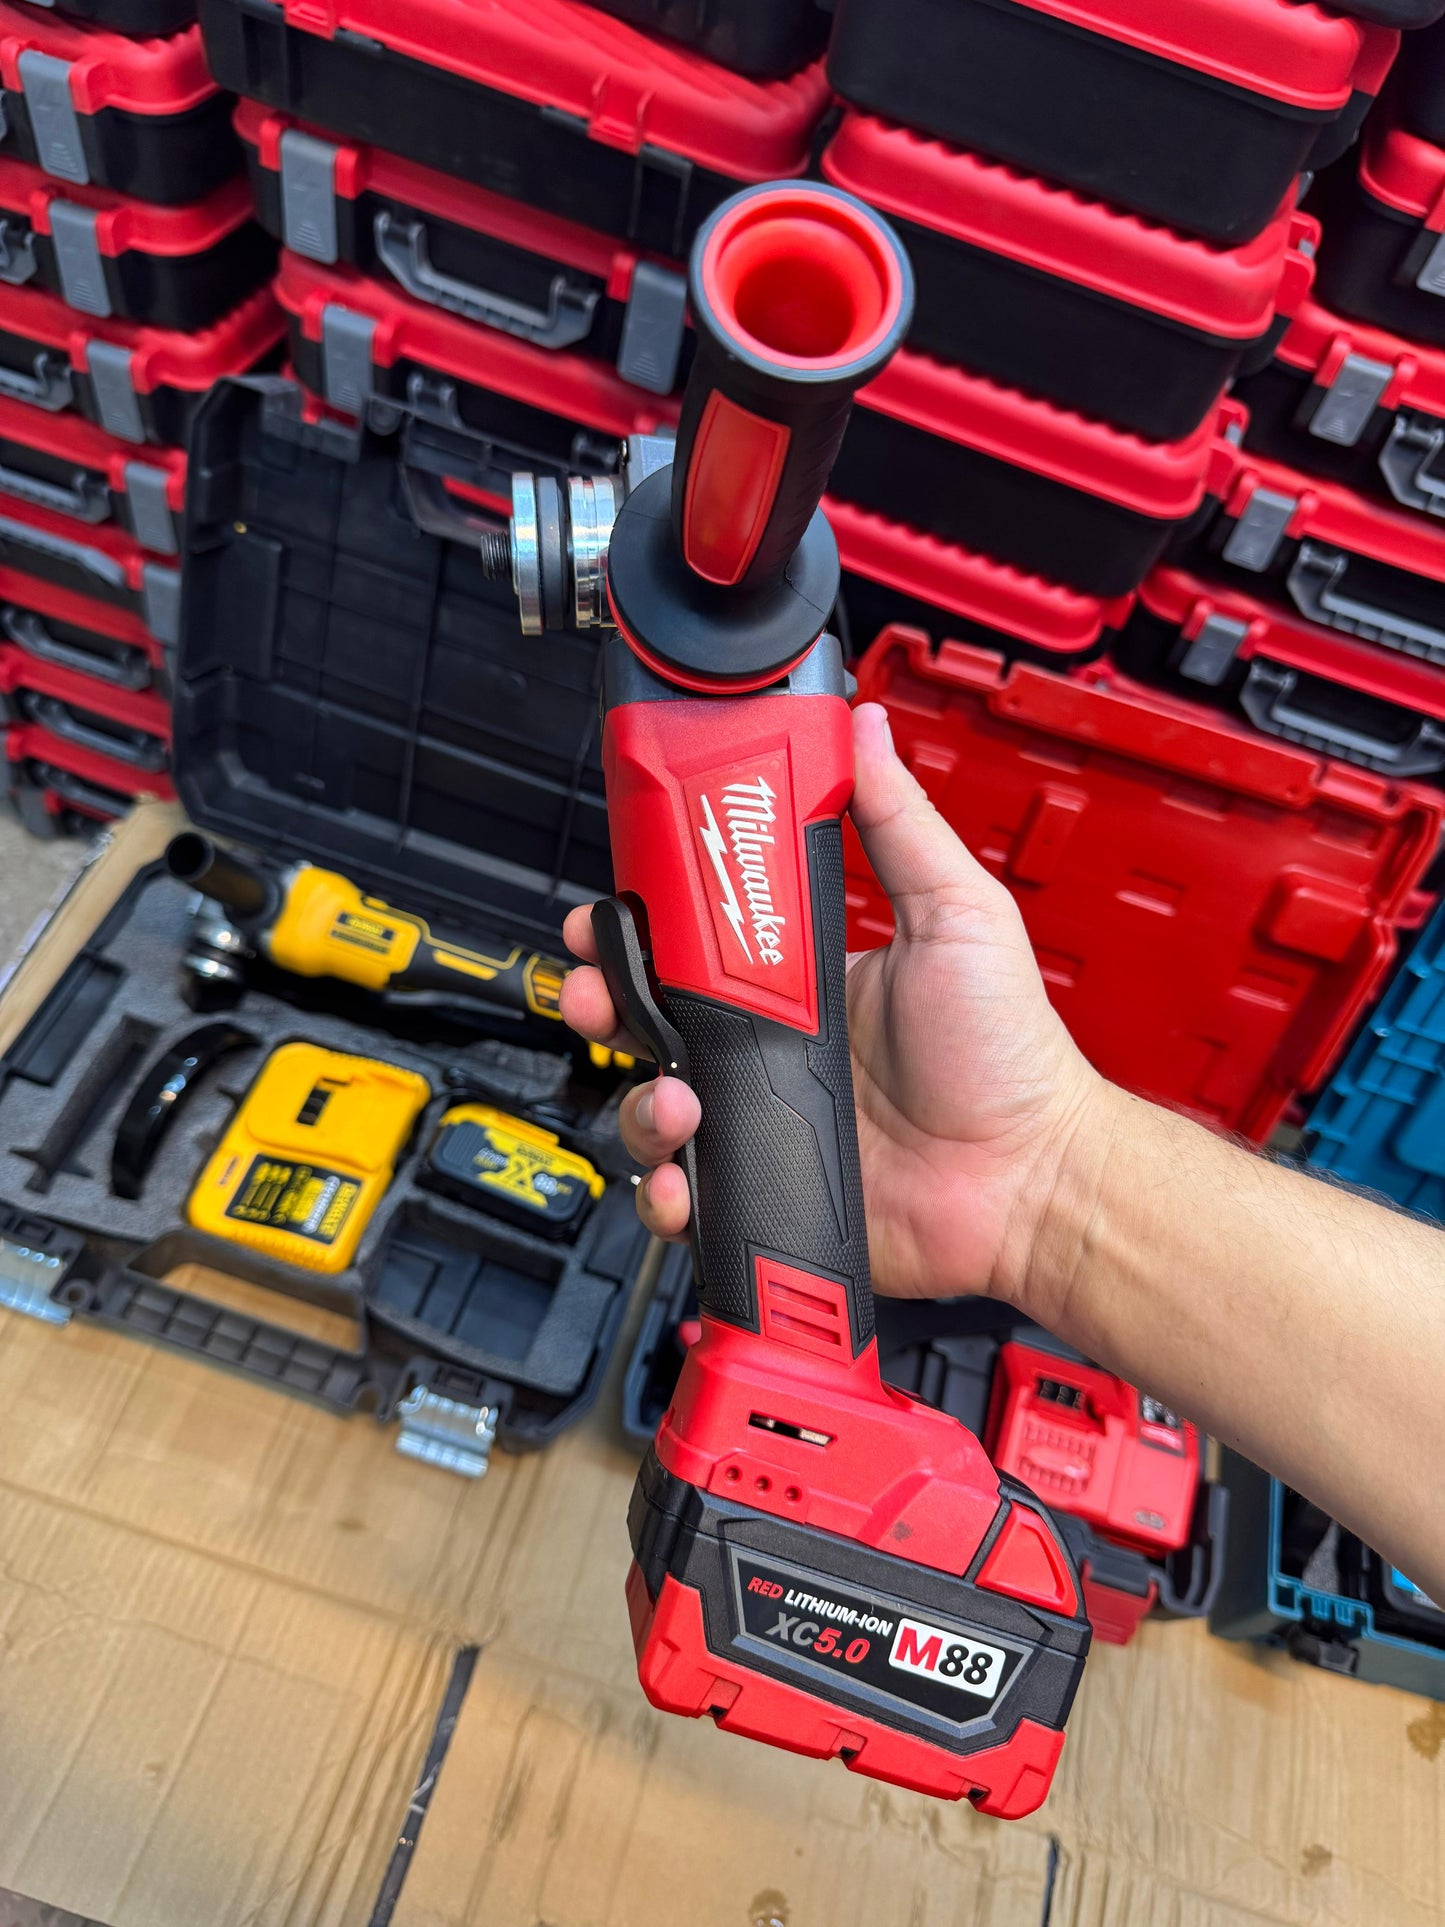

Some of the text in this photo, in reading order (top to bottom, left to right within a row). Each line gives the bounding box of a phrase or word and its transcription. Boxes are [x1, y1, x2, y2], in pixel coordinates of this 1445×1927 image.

[721, 776, 786, 966] Milwaukee
[747, 1576, 893, 1637] RED LITHIUM-ION
[765, 1611, 871, 1665] XC5.0
[894, 1626, 993, 1686] M88
